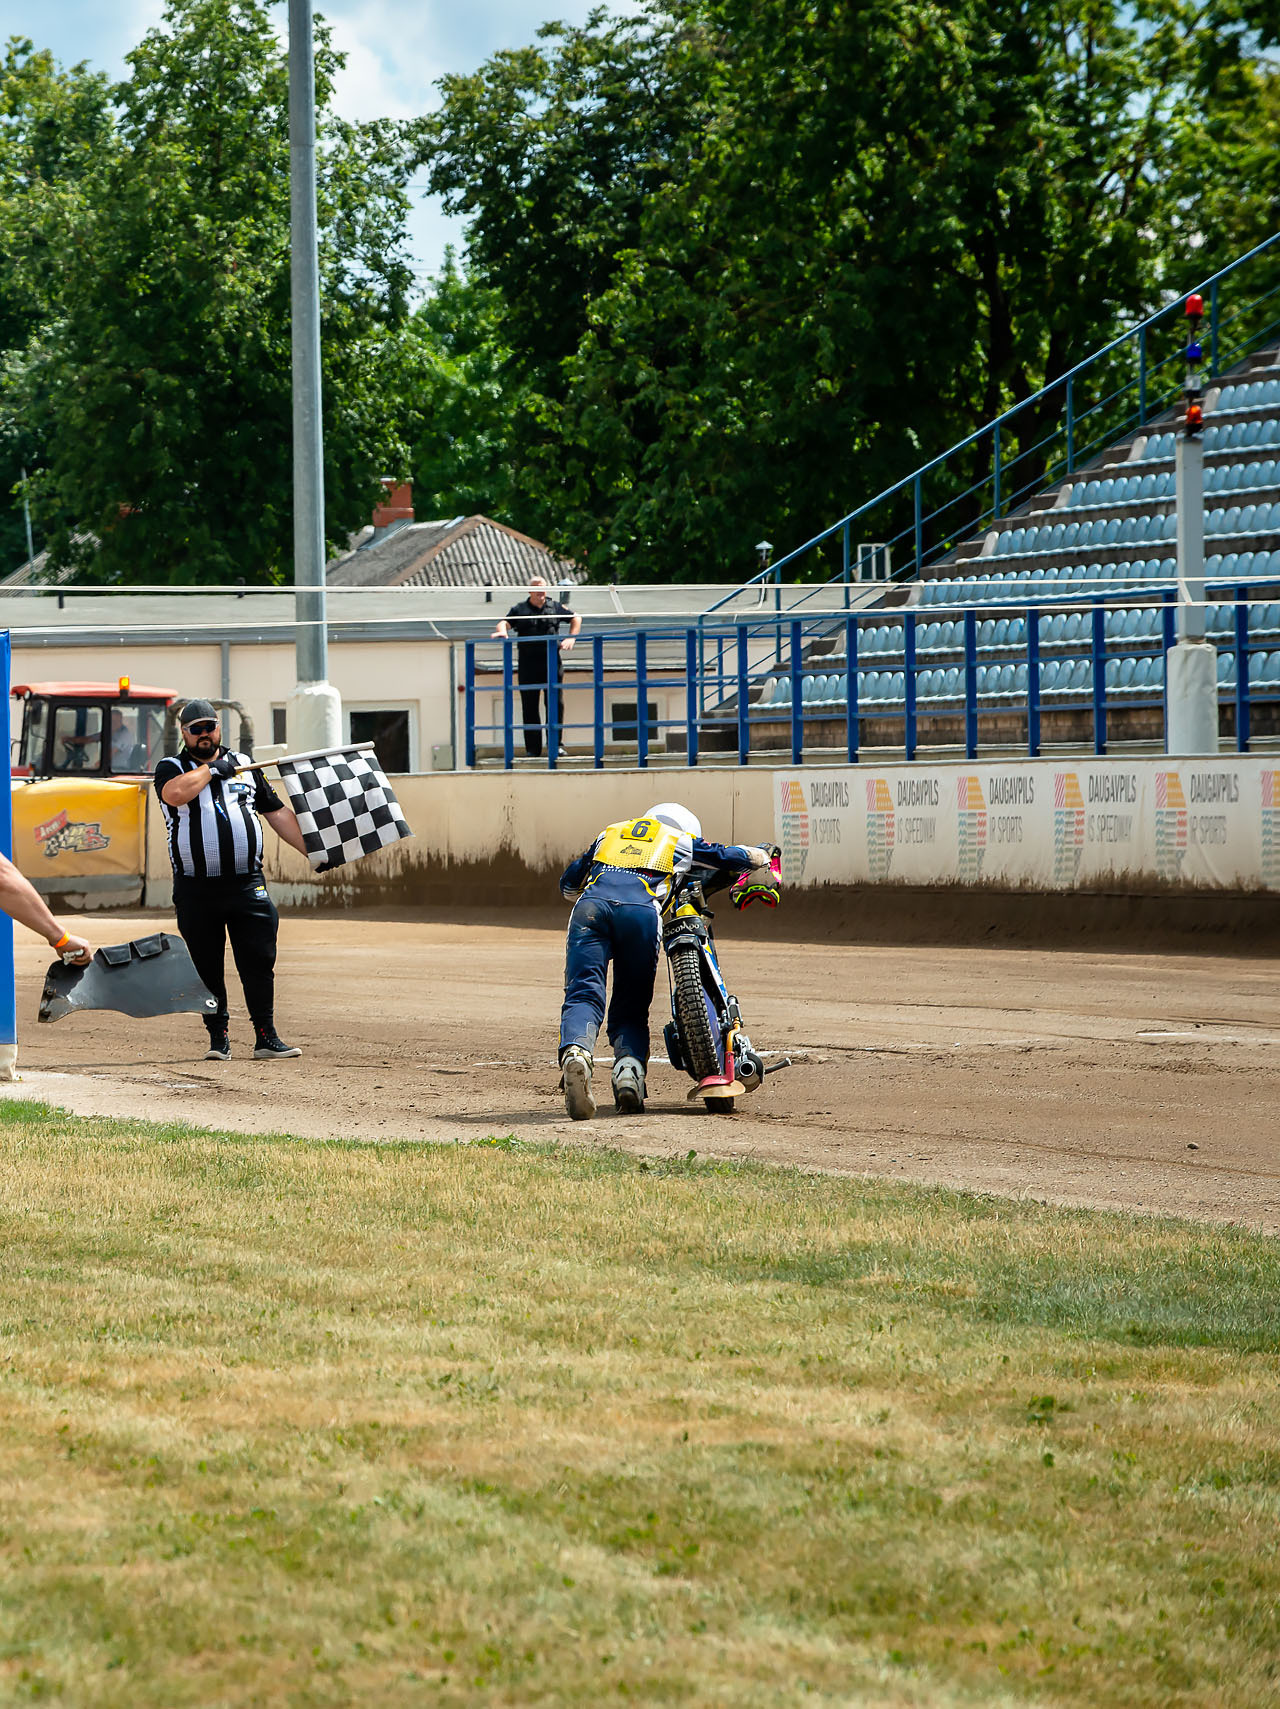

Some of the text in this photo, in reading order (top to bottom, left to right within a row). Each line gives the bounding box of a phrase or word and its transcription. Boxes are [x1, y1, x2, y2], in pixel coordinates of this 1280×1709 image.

[810, 782, 850, 808] DAUGAVPILS
[898, 779, 939, 807] DAUGAVPILS
[990, 776, 1034, 805] DAUGAVPILS
[1089, 774, 1137, 803] DAUGAVPILS
[1190, 773, 1239, 803] DAUGAVPILS
[631, 820, 651, 838] 6
[820, 819, 841, 844] SPORTS
[905, 818, 937, 843] SPEEDWAY
[998, 816, 1023, 843] SPORTS
[1097, 815, 1133, 842] SPEEDWAY
[1200, 816, 1227, 844] SPORTS
